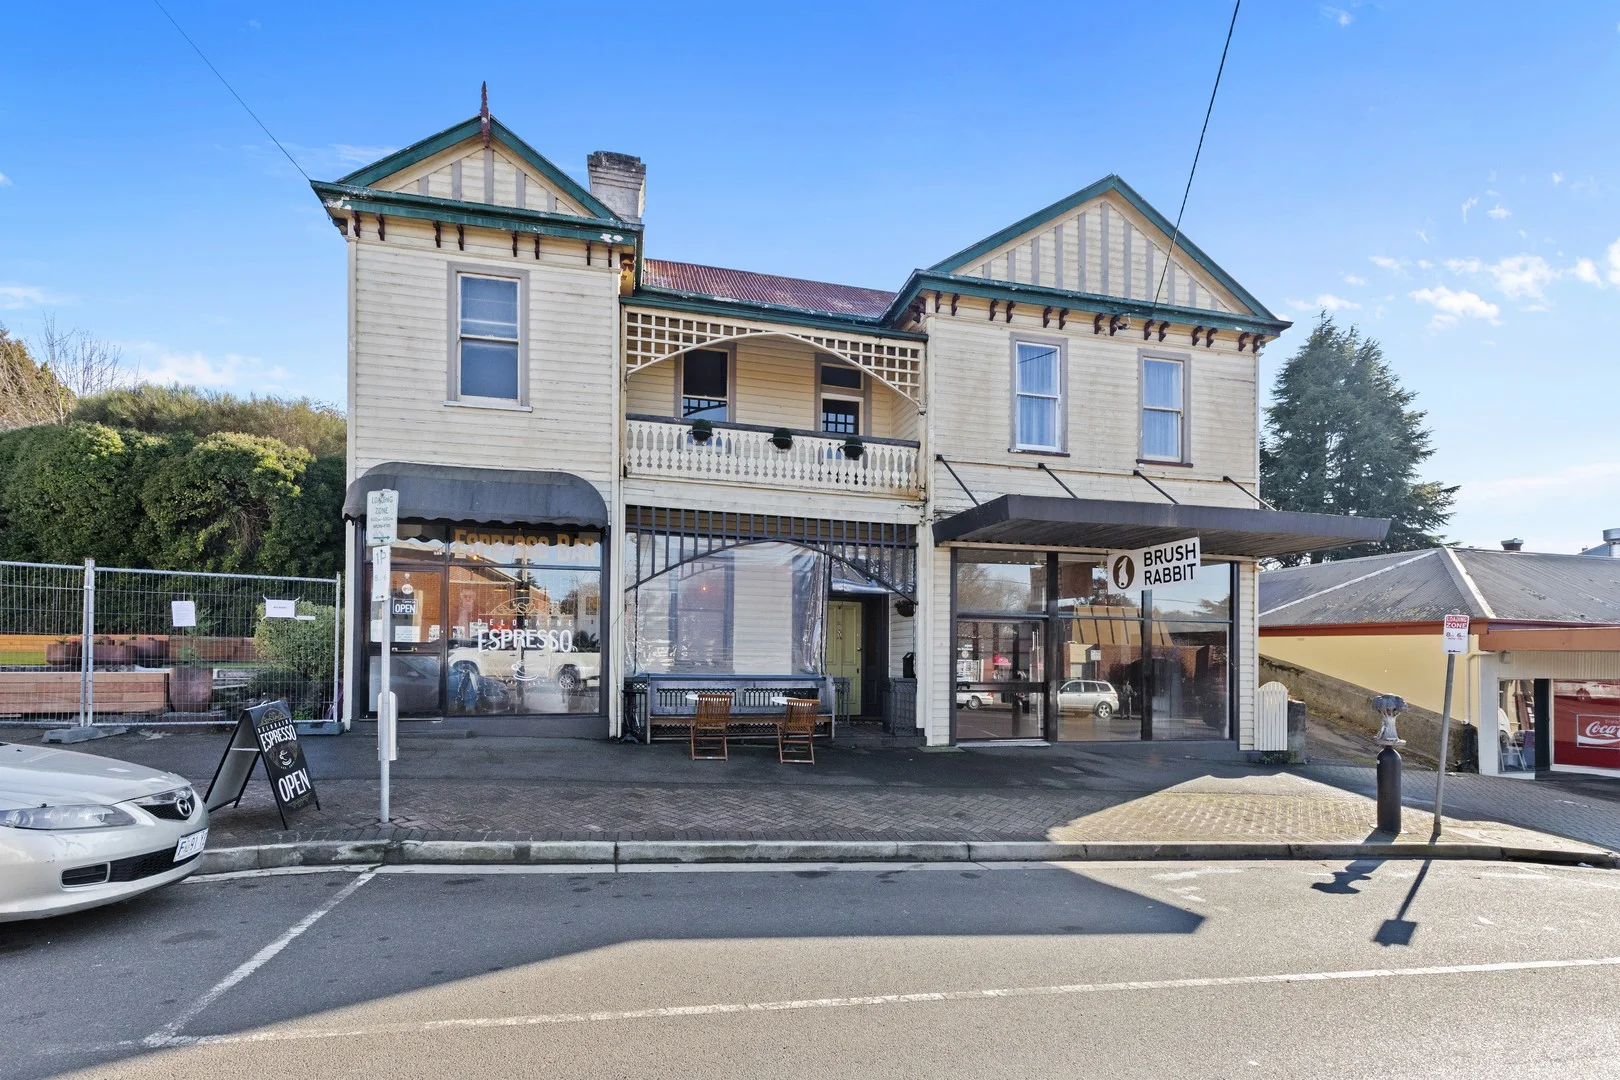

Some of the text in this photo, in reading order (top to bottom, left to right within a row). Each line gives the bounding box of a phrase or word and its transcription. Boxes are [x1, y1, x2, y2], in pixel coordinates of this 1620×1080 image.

[454, 529, 595, 561] ESPRESSO BAR
[1144, 542, 1196, 567] BRUSH
[1144, 563, 1196, 586] RABBIT
[395, 604, 416, 613] OPEN
[478, 629, 573, 653] ESPRESSO
[260, 724, 297, 752] ESPRESSO
[278, 768, 312, 802] OPEN
